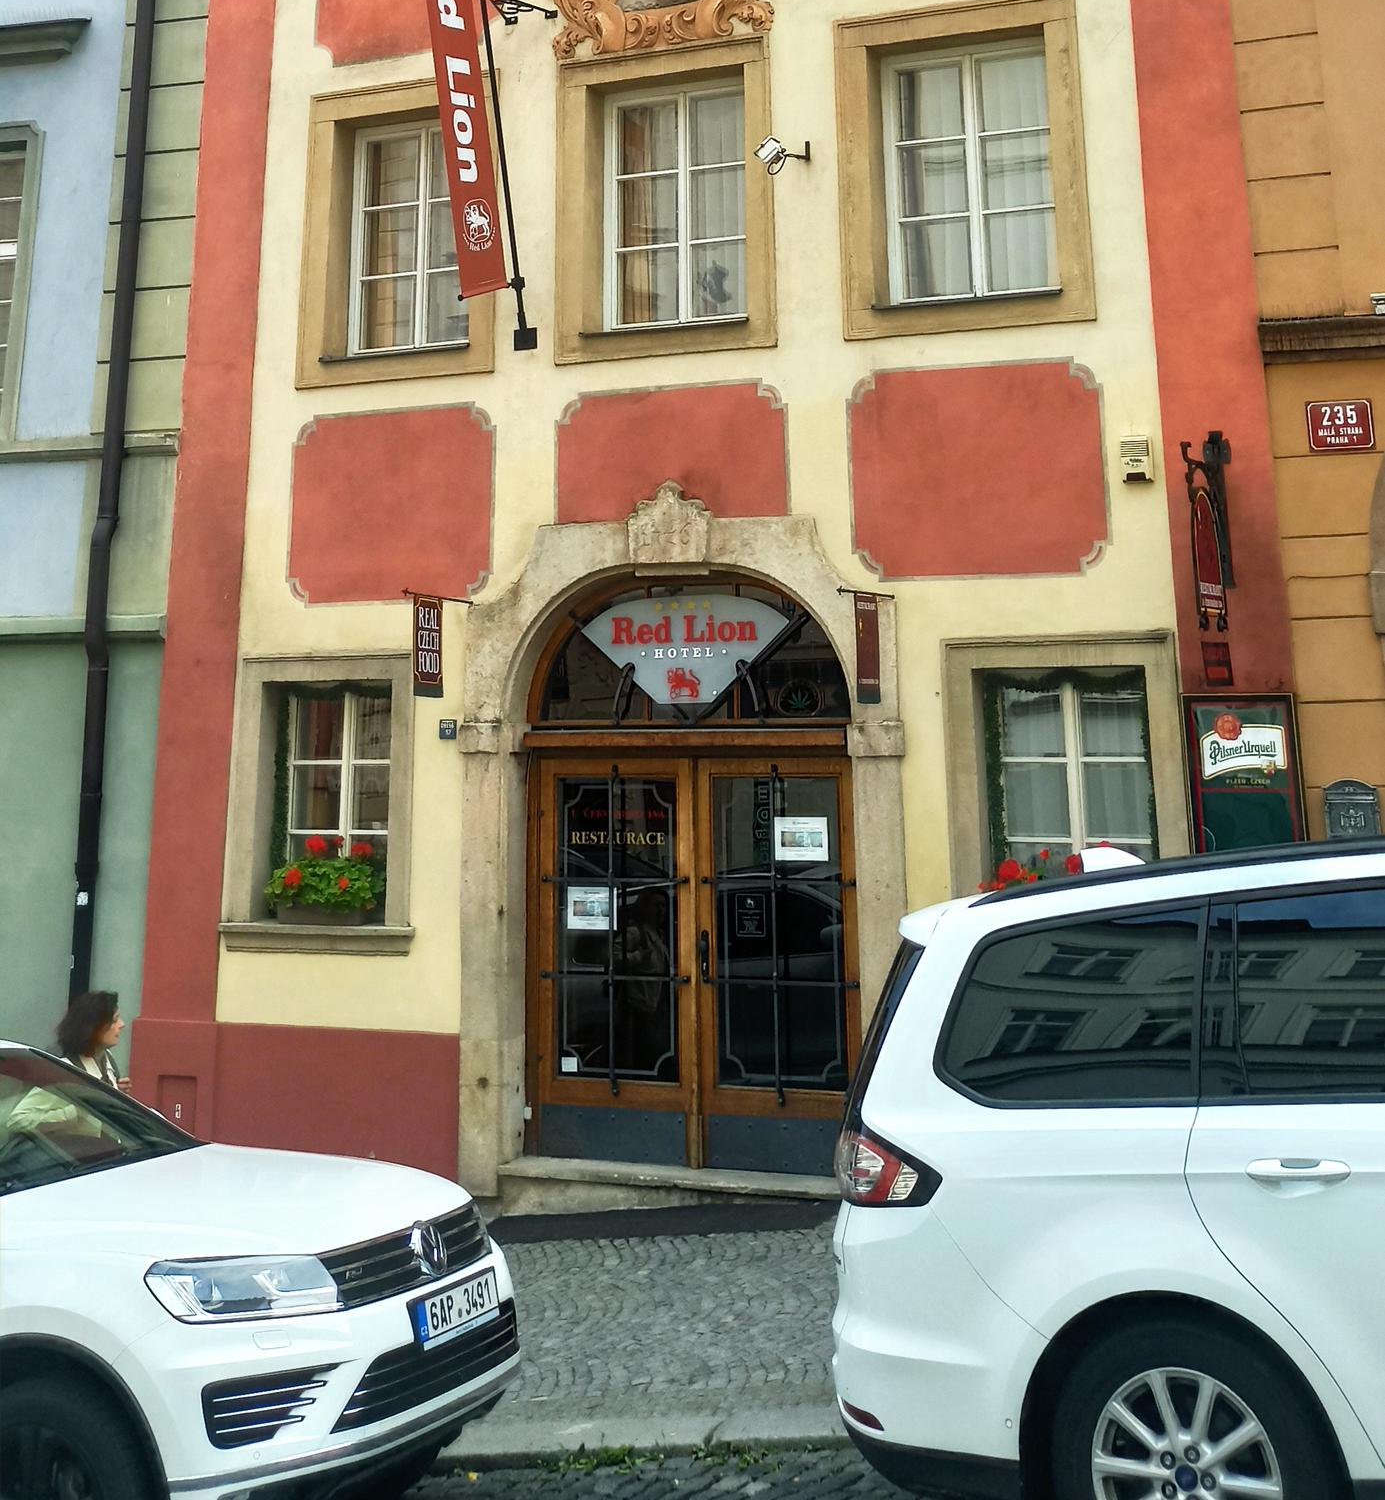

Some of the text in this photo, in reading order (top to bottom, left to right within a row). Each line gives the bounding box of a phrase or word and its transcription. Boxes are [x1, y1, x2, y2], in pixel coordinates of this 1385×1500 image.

[445, 55, 480, 183] Lion
[1321, 404, 1357, 426] 235
[1318, 426, 1363, 436] MALÁ STRANA
[1327, 436, 1349, 444] PRAHA
[418, 607, 440, 629] REAL
[418, 630, 440, 650] CZECH
[611, 615, 758, 645] Red Lion
[418, 651, 440, 674] FOOD
[653, 647, 715, 659] HOTEL
[1209, 740, 1277, 765] Pilsner Urquell
[429, 1277, 492, 1331] 6AP 3491
[420, 1326, 428, 1336] CZ
